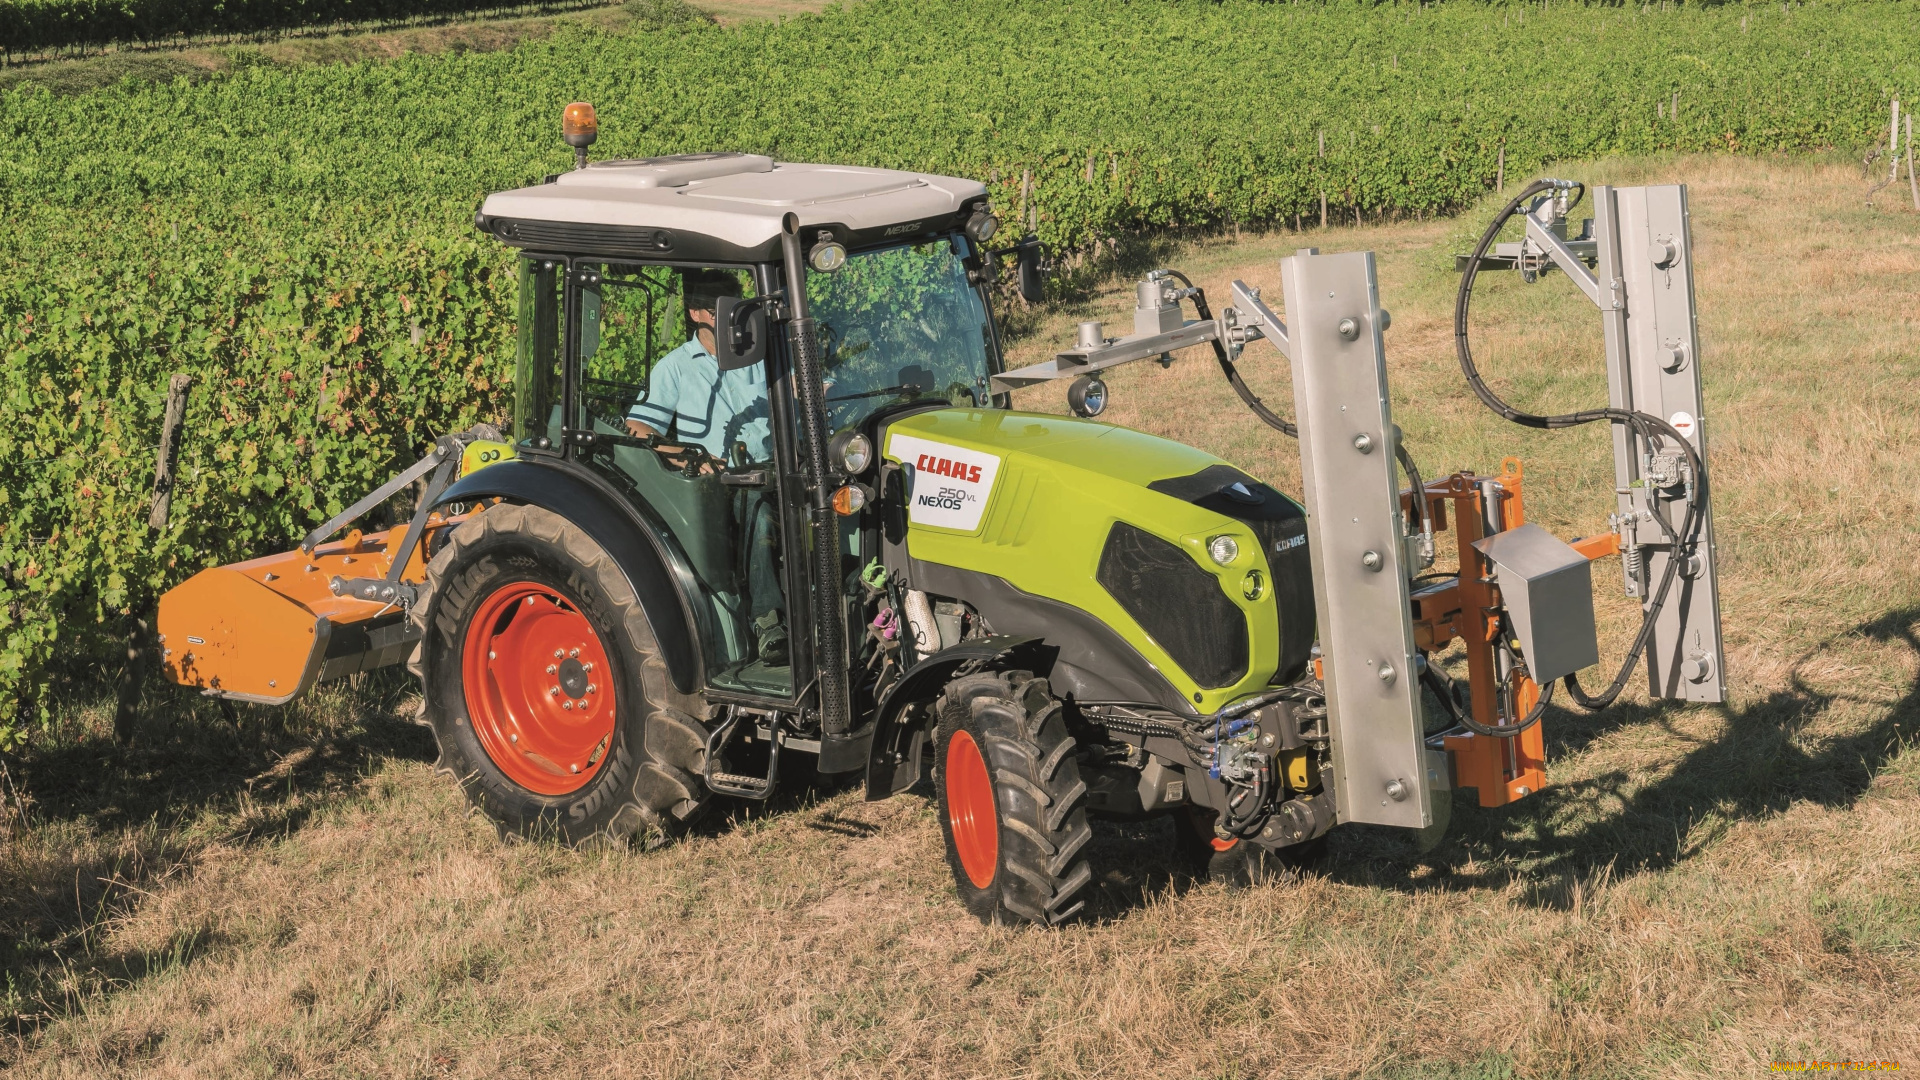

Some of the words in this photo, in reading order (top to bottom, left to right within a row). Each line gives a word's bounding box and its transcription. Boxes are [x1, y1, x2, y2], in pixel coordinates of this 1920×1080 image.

[884, 222, 922, 236] NEXOS
[916, 454, 982, 483] CLAAS
[938, 487, 966, 500] 250
[918, 495, 962, 510] NEXOS
